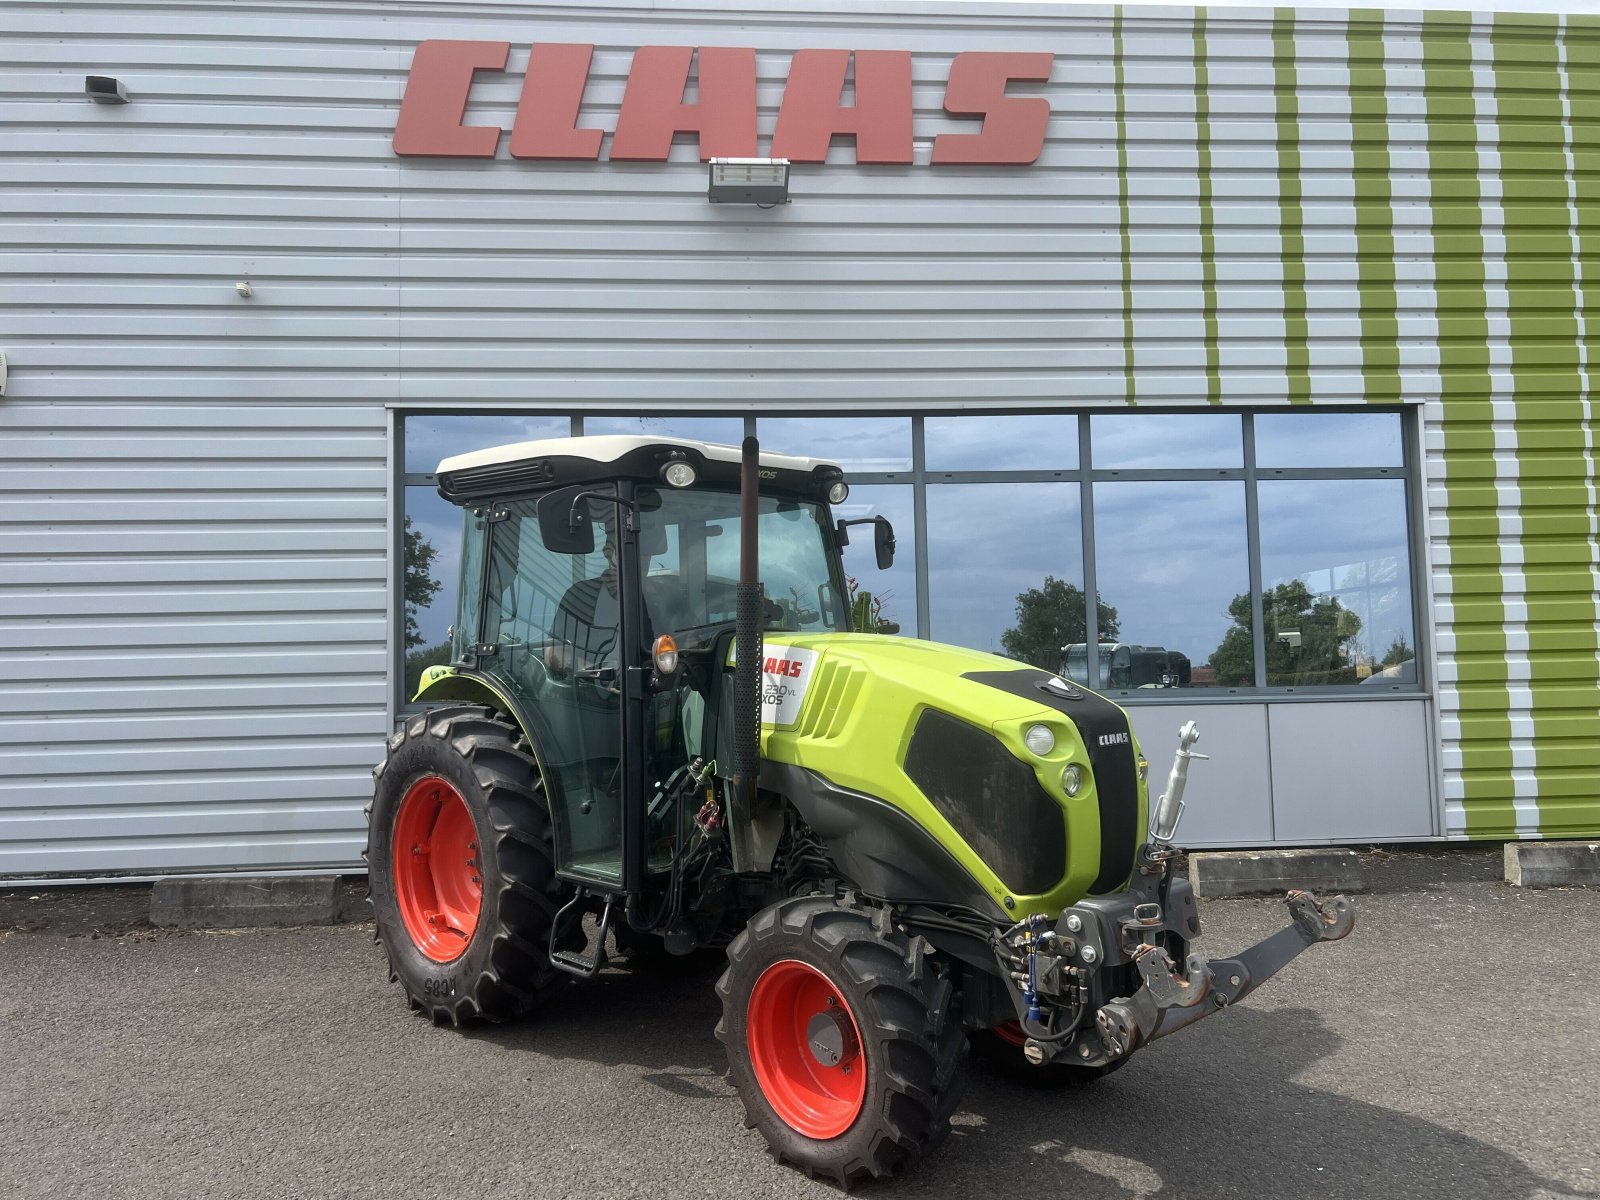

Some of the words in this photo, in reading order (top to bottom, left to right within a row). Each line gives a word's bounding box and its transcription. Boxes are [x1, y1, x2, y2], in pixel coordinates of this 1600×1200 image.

[393, 39, 1054, 166] CLAAS
[763, 657, 803, 678] AAS
[761, 694, 784, 705] XOS
[1098, 732, 1129, 746] CLAAS
